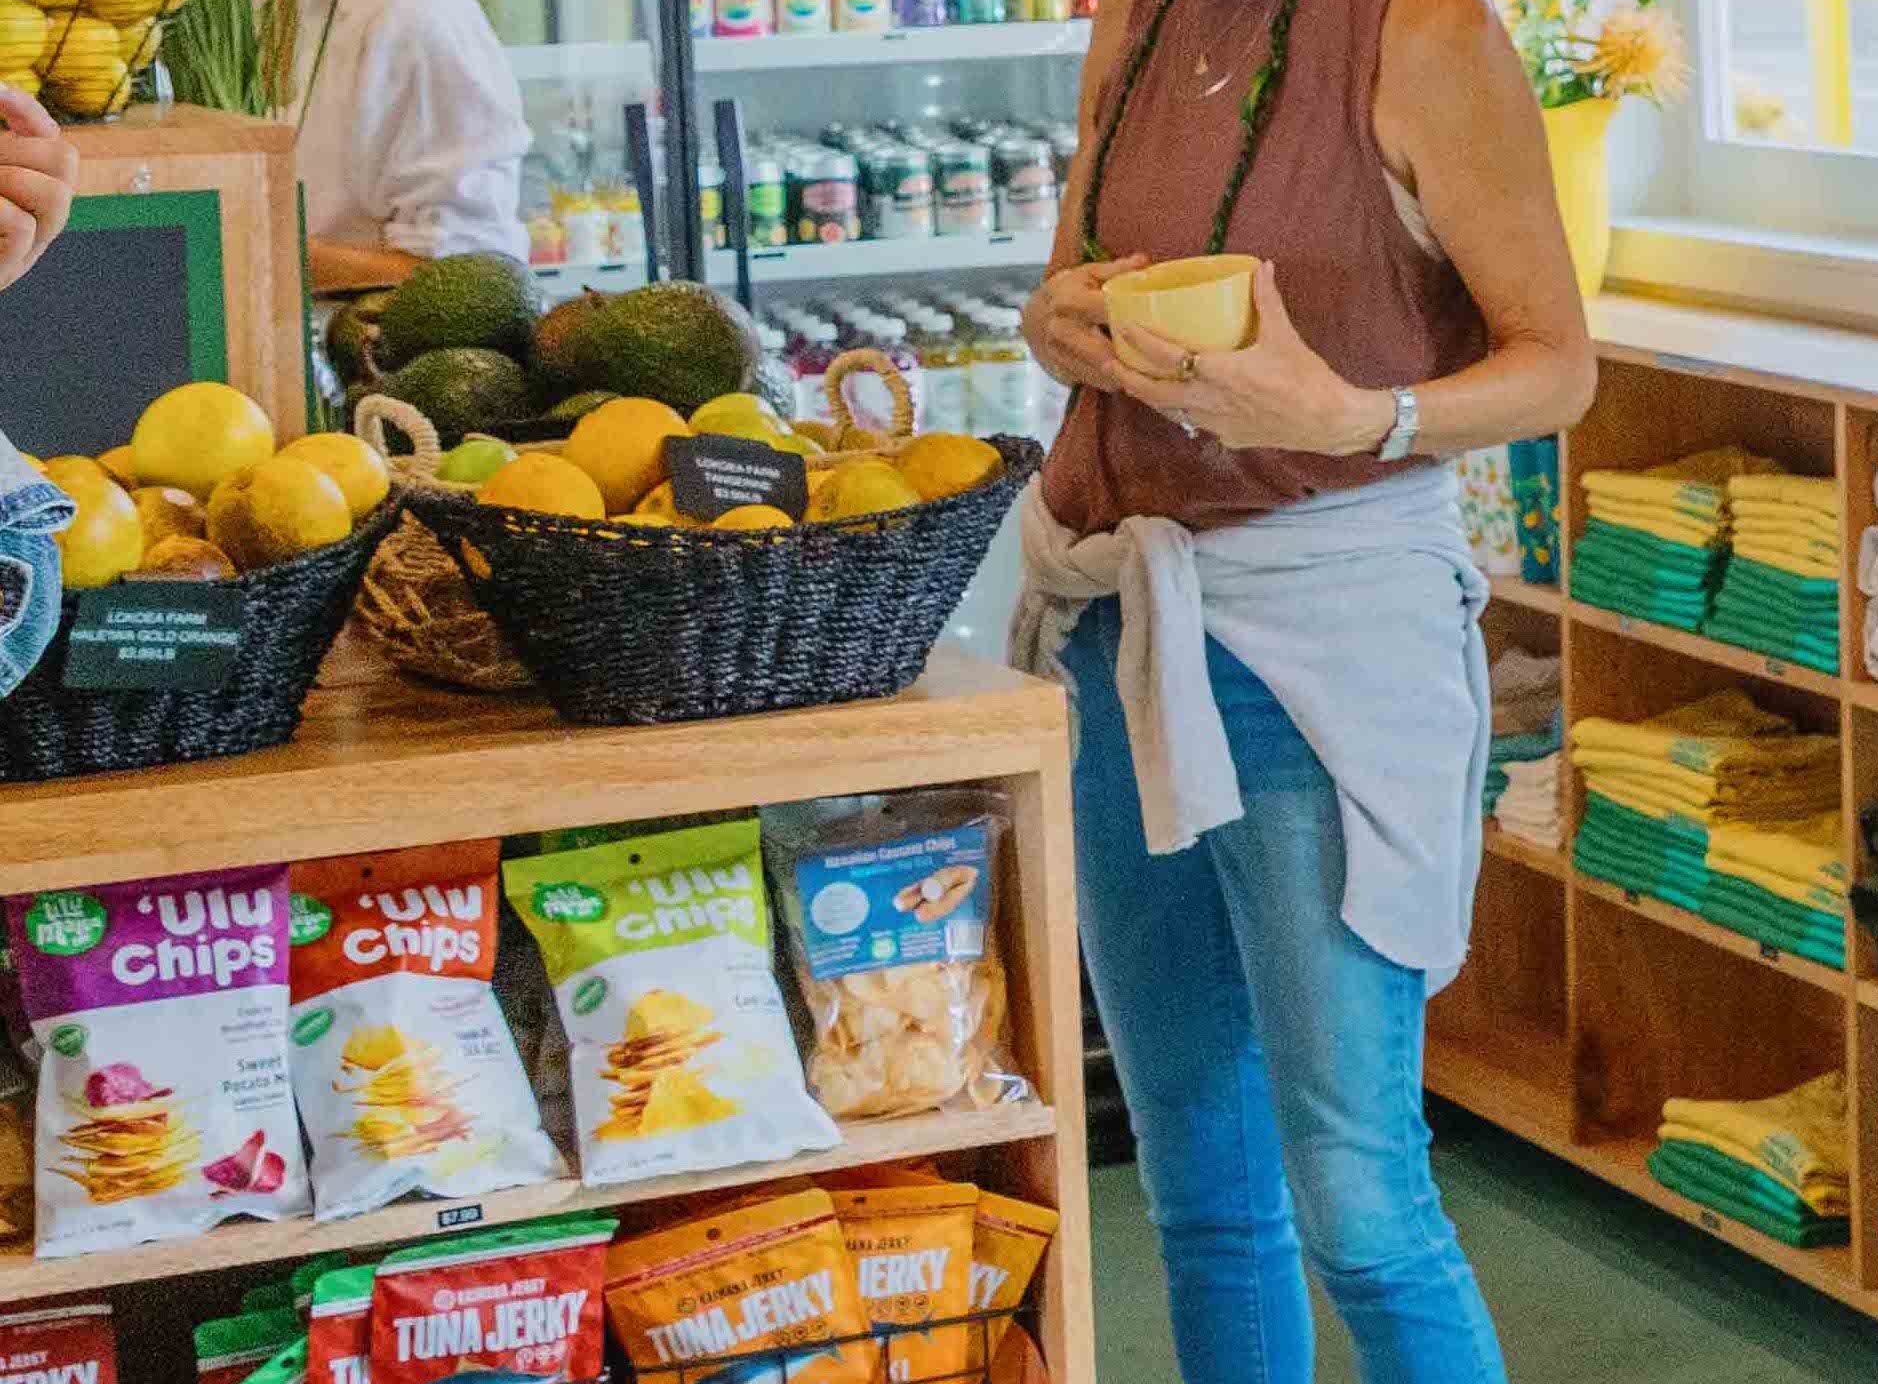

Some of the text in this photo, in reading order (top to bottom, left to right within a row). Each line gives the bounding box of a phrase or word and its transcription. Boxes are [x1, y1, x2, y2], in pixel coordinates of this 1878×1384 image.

[393, 1289, 588, 1363] TUNA JERKY
[645, 1268, 834, 1366] TUNA JERKY
